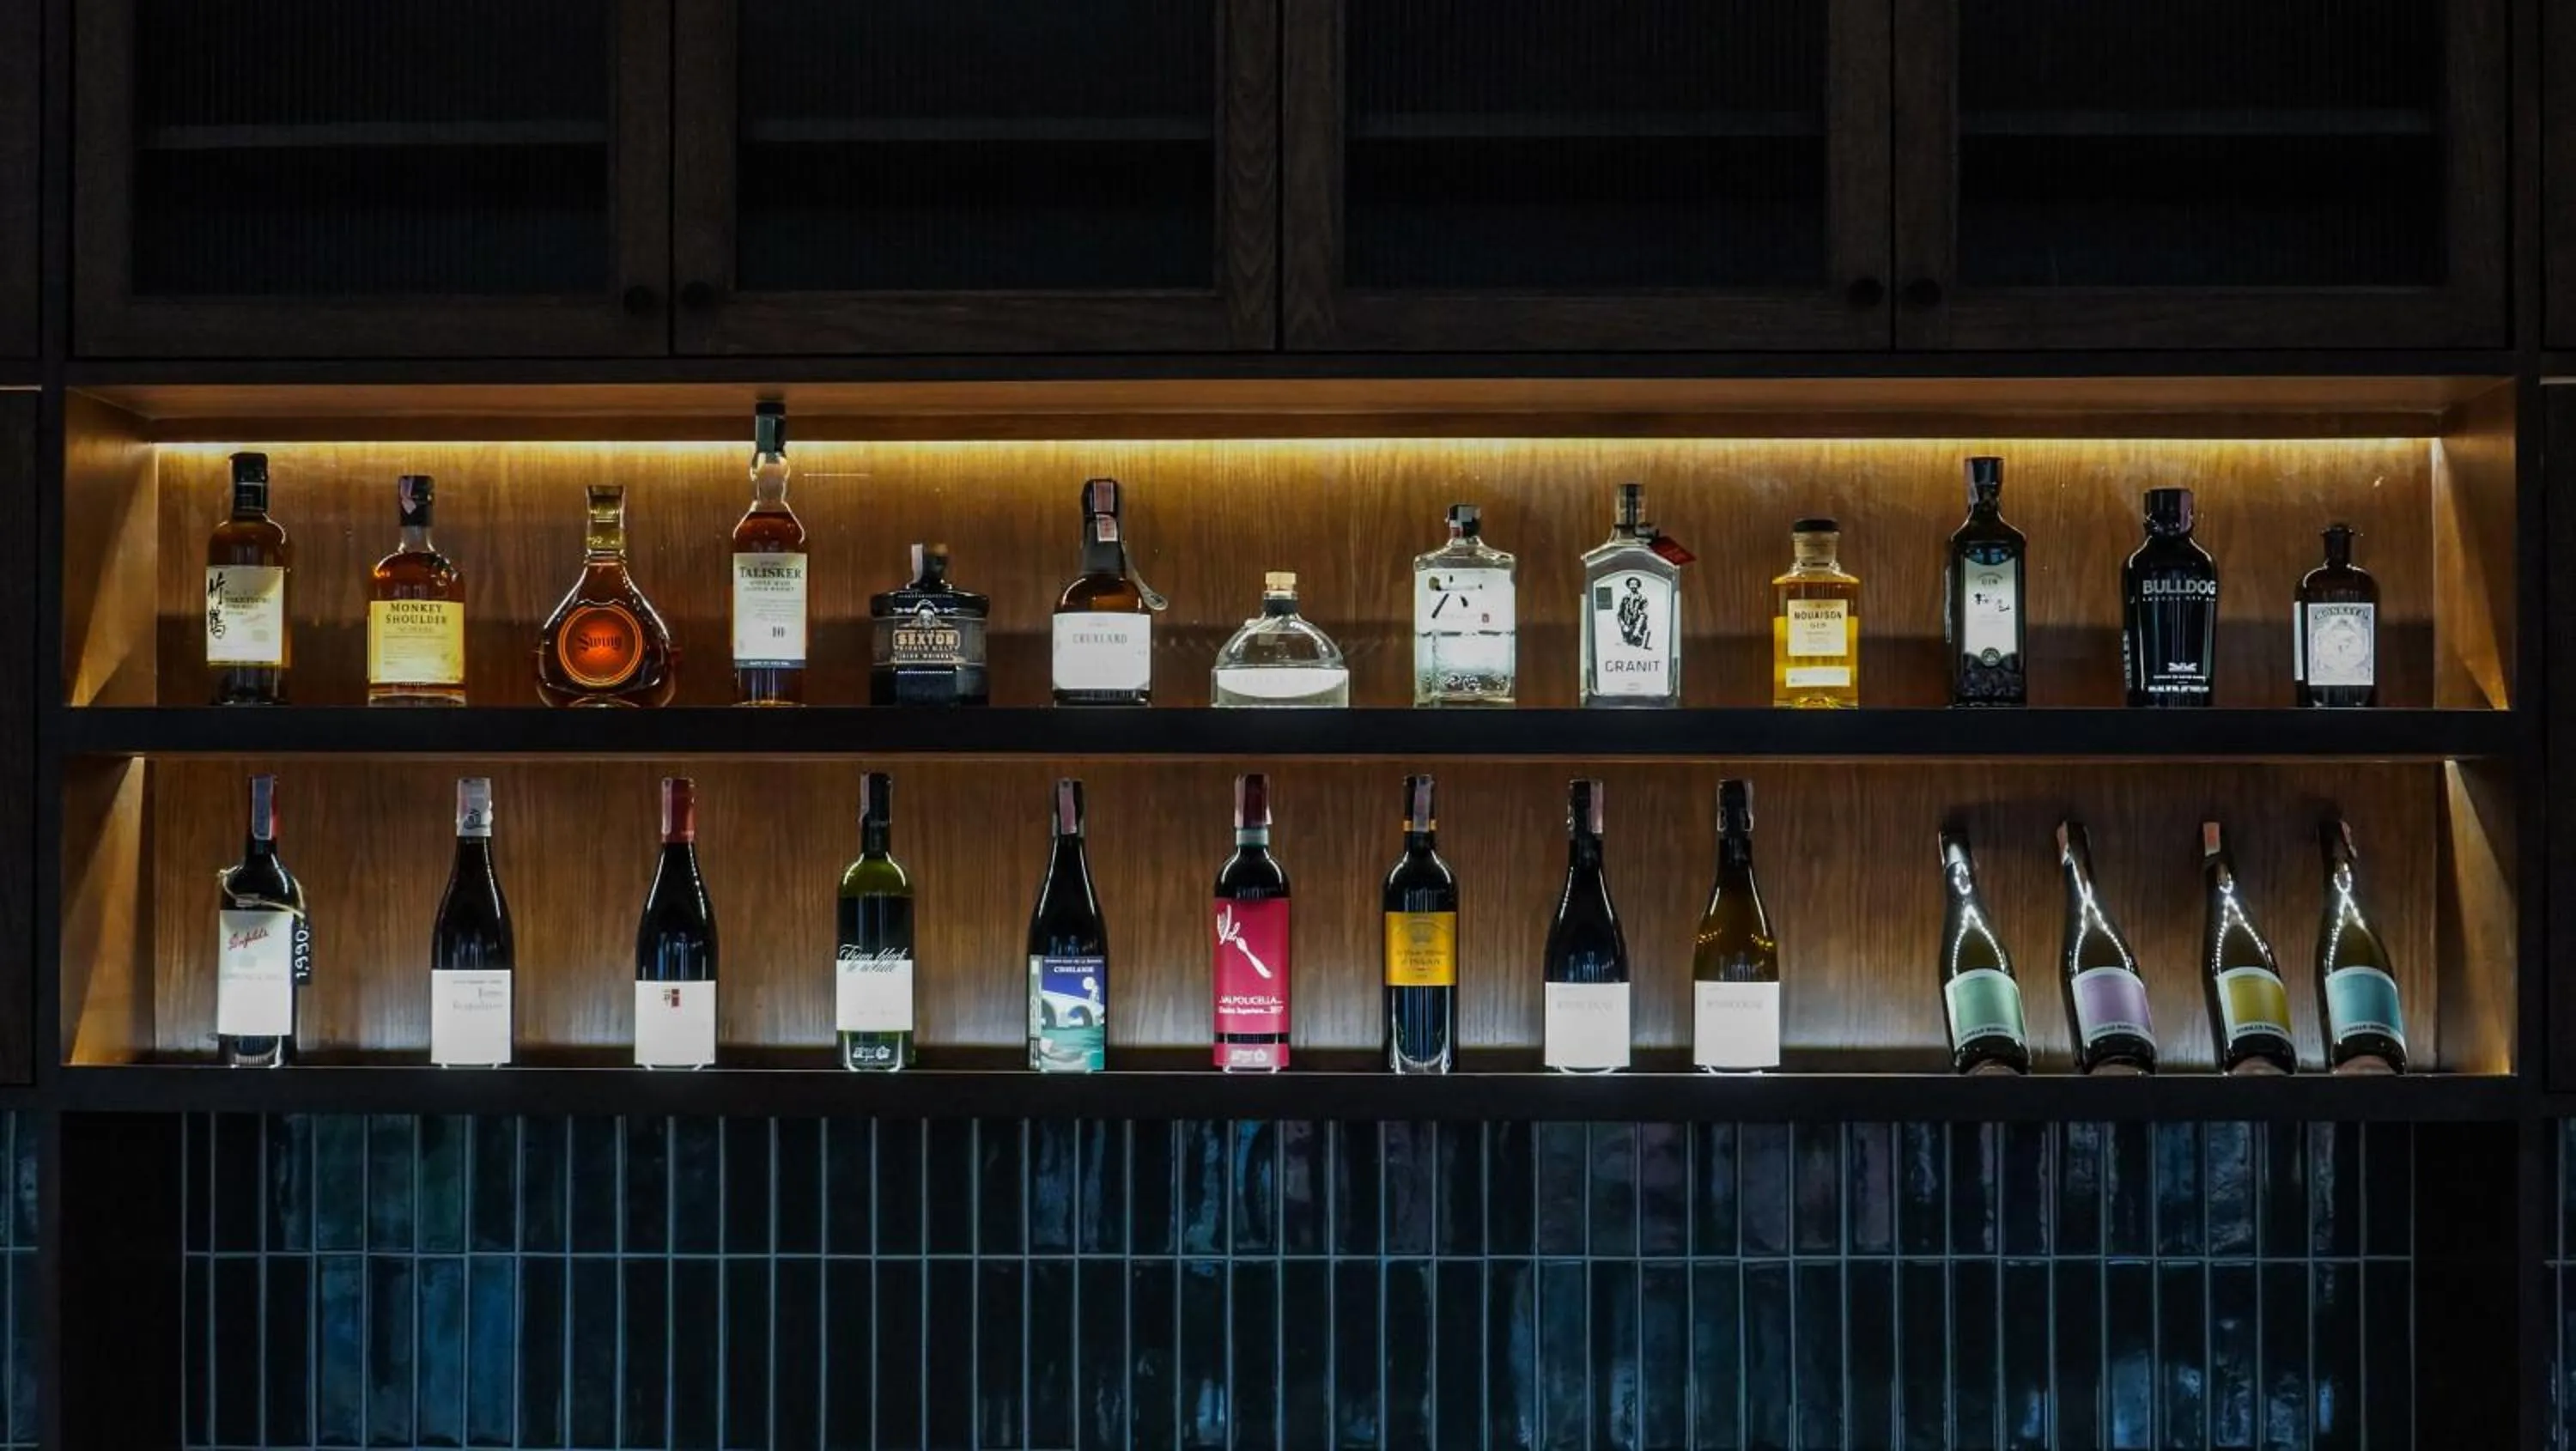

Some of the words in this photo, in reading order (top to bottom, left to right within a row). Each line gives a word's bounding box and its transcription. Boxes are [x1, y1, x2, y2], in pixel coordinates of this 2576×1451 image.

[739, 566, 802, 579] TALISKER
[2142, 579, 2216, 596] BULLDOG
[391, 604, 442, 613] MONKEY
[386, 614, 448, 624] SHOULDER
[772, 626, 785, 638] 10
[898, 633, 954, 646] SEXTON
[1605, 660, 1660, 672] GRANIT
